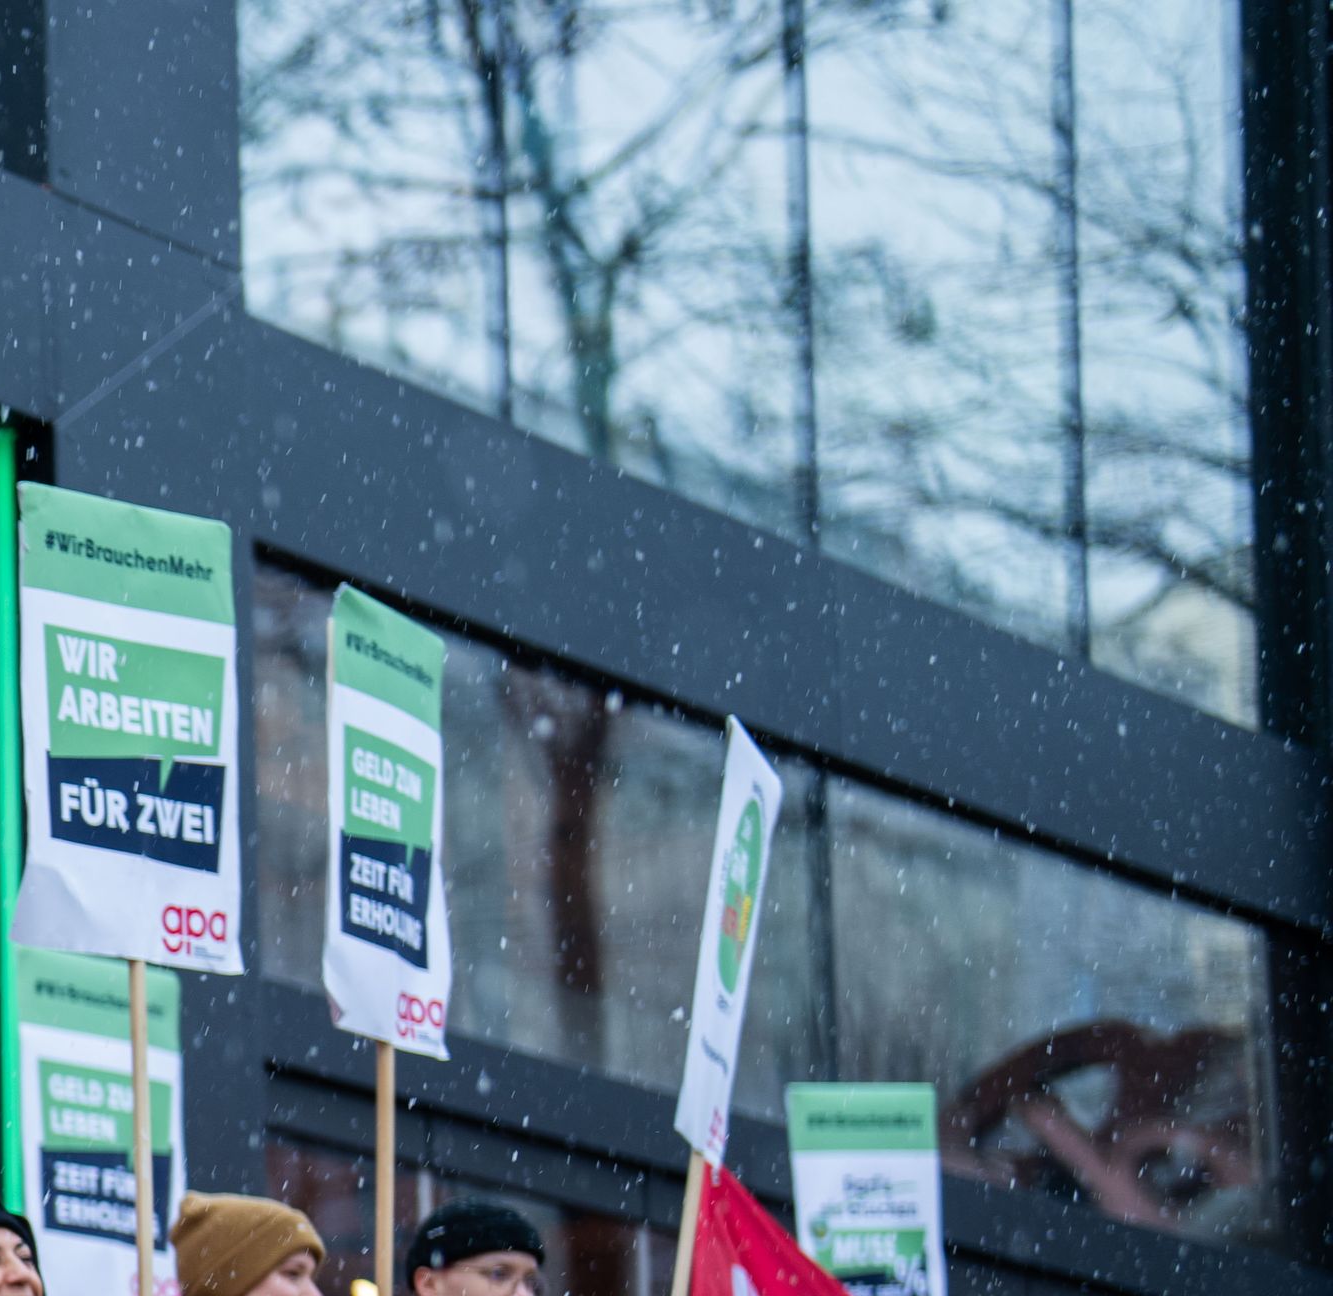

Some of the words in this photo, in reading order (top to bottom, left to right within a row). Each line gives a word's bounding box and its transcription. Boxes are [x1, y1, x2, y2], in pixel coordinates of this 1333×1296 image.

[44, 530, 214, 581] #WirBrauchenMehr
[56, 634, 119, 684] WIR
[56, 683, 214, 747] ARBEITEN
[60, 777, 128, 833] FÜR
[137, 796, 215, 845] ZWEI
[349, 851, 387, 892] ZEIT
[161, 903, 227, 956] gpa
